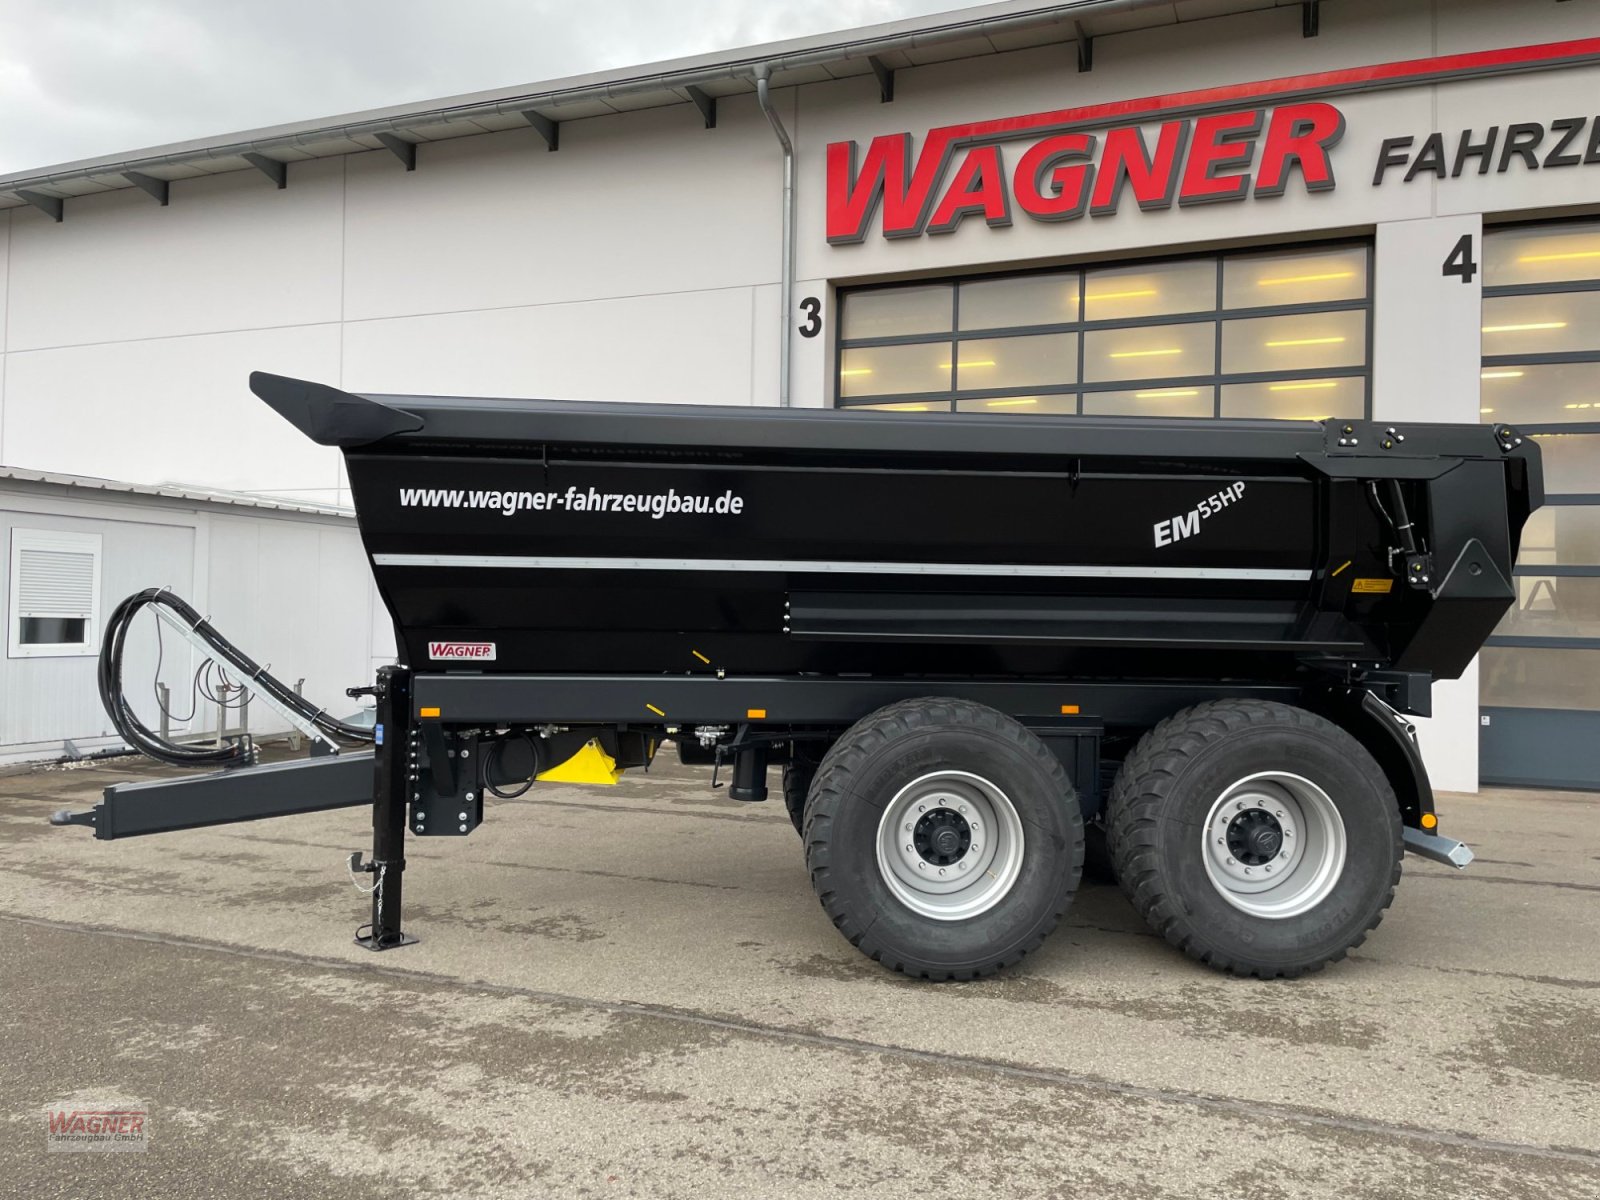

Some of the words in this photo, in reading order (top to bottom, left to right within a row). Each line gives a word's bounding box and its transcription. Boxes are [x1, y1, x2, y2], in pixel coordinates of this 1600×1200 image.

[826, 102, 1346, 246] WAGNER
[1442, 234, 1477, 283] 4
[798, 296, 822, 338] 3
[399, 486, 744, 519] www.wagner-fahrzeugbau.de
[431, 643, 491, 657] WAGNER
